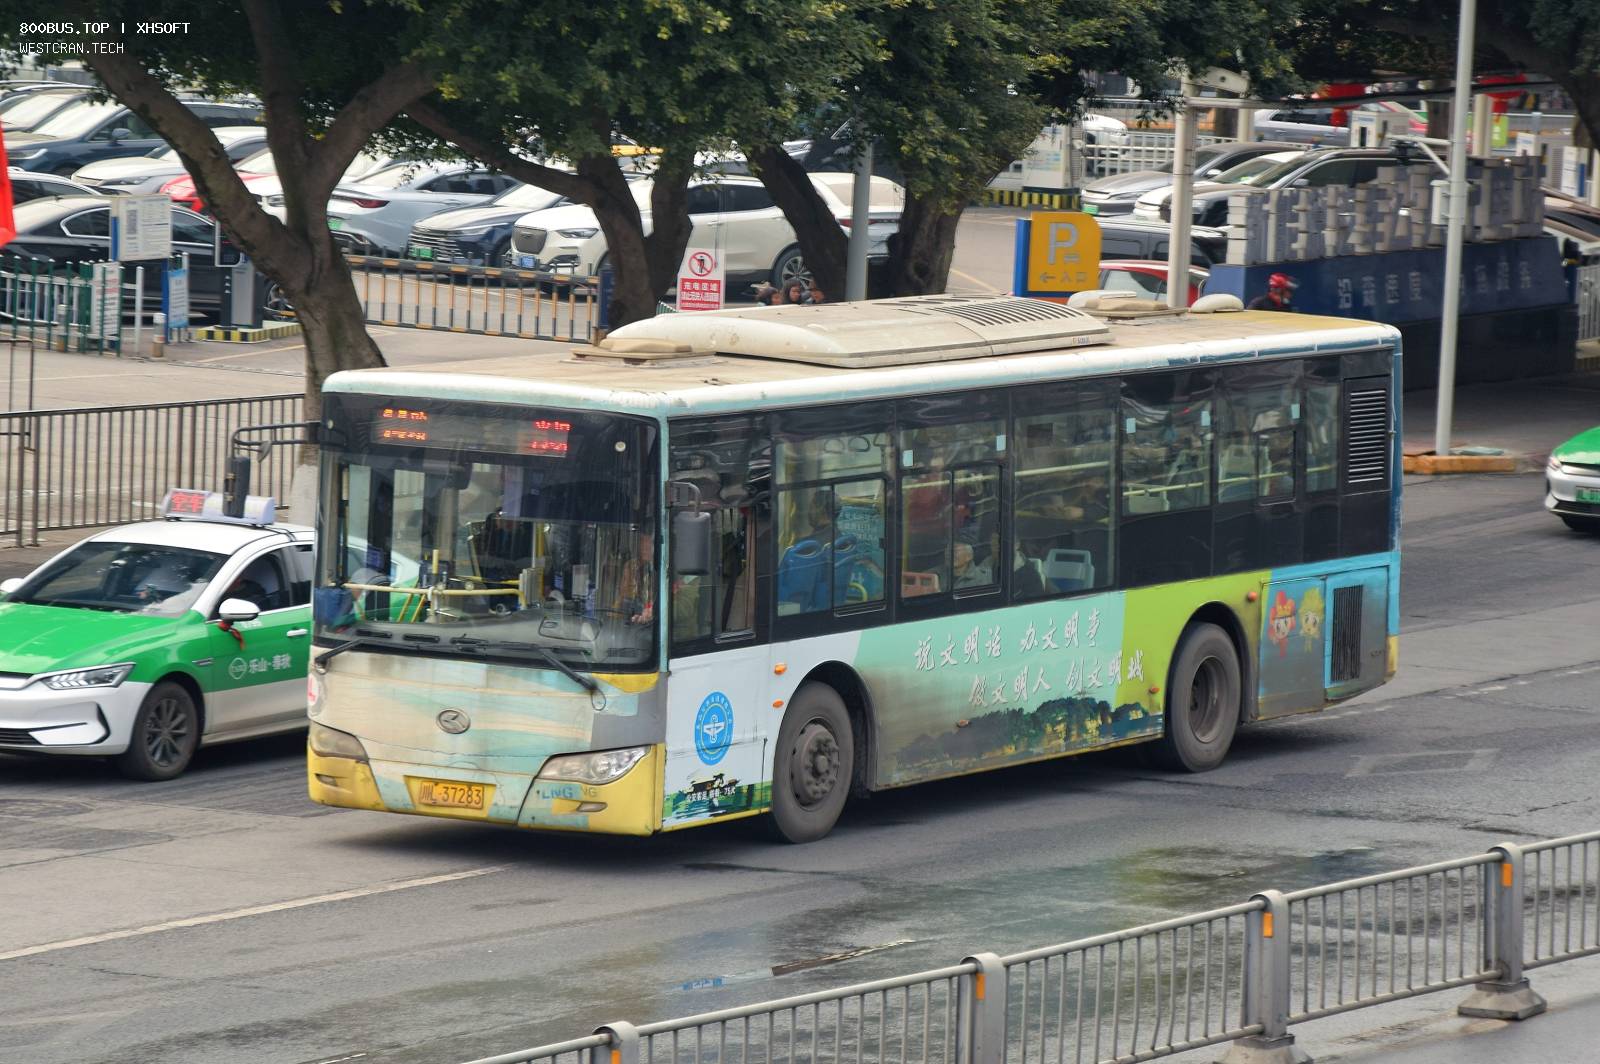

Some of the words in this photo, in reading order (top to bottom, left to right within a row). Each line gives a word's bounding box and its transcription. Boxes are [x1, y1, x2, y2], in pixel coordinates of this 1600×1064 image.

[1047, 222, 1078, 265] P
[1065, 649, 1144, 691] 创文明城
